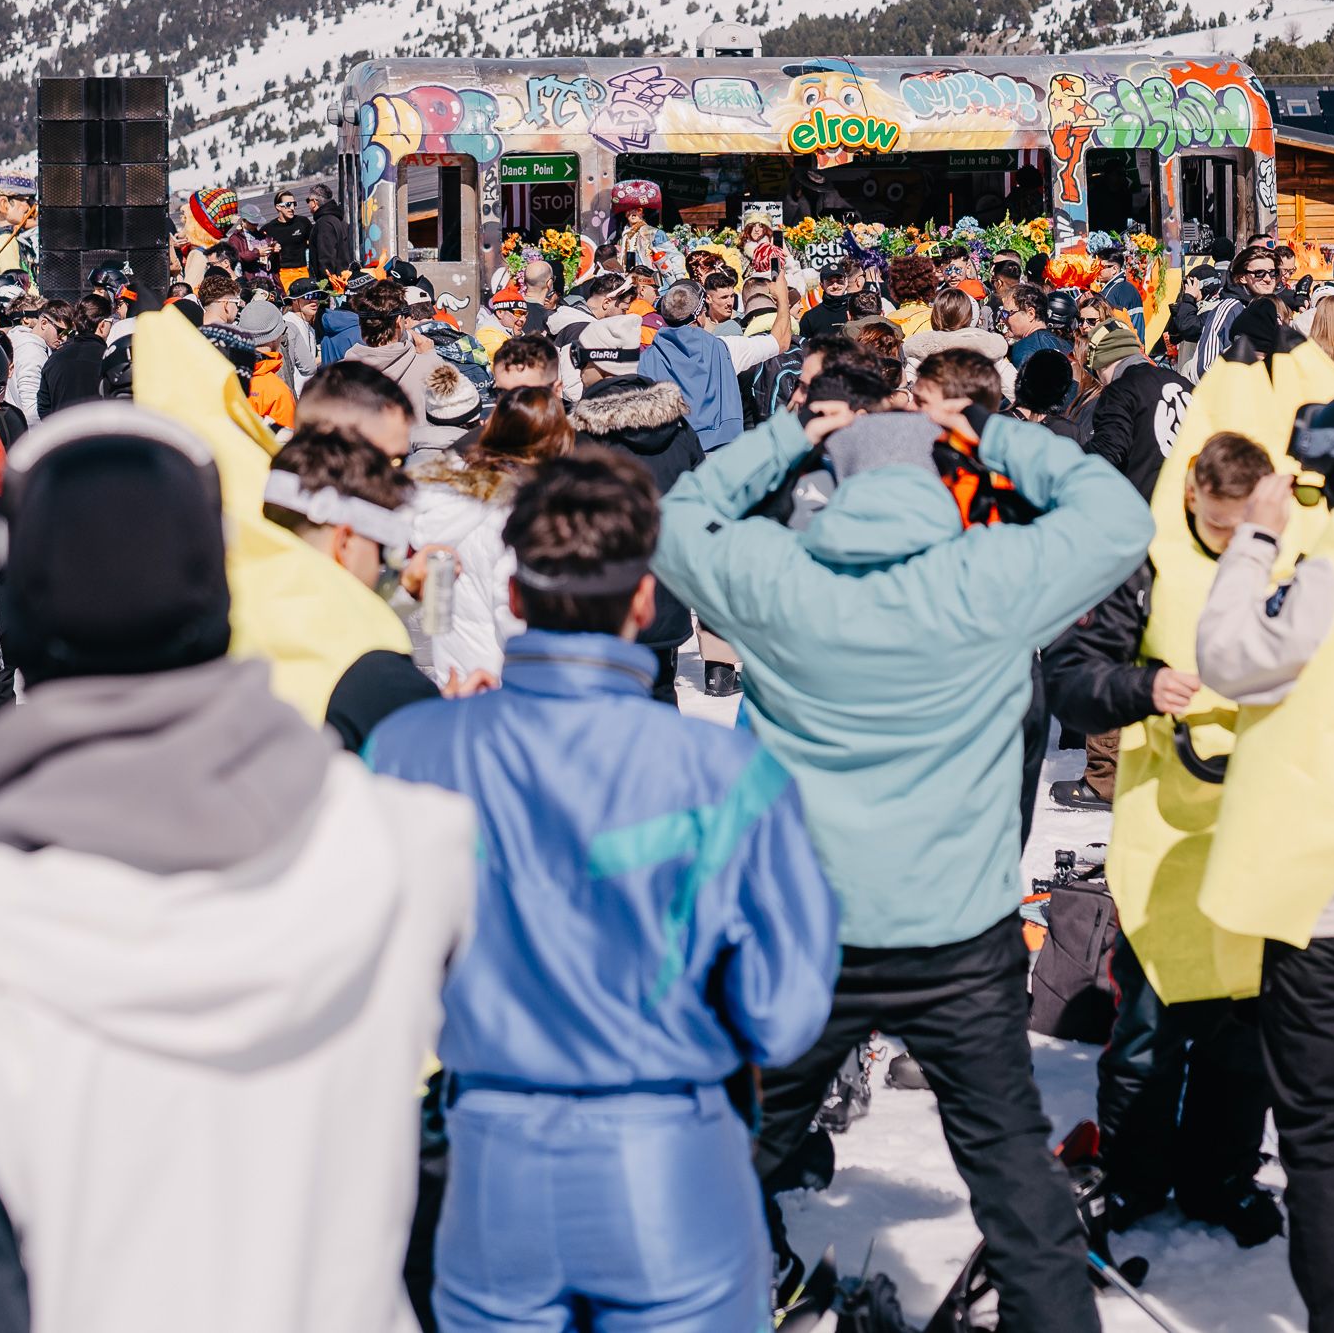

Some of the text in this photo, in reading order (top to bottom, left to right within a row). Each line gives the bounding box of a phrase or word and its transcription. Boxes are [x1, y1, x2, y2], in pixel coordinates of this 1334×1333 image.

[791, 109, 899, 150] elrow
[949, 155, 966, 166] Local
[968, 156, 975, 166] to
[978, 155, 988, 166] the
[502, 163, 554, 177] Dance Point
[532, 195, 573, 211] STOP
[589, 350, 619, 360] GlaRid
